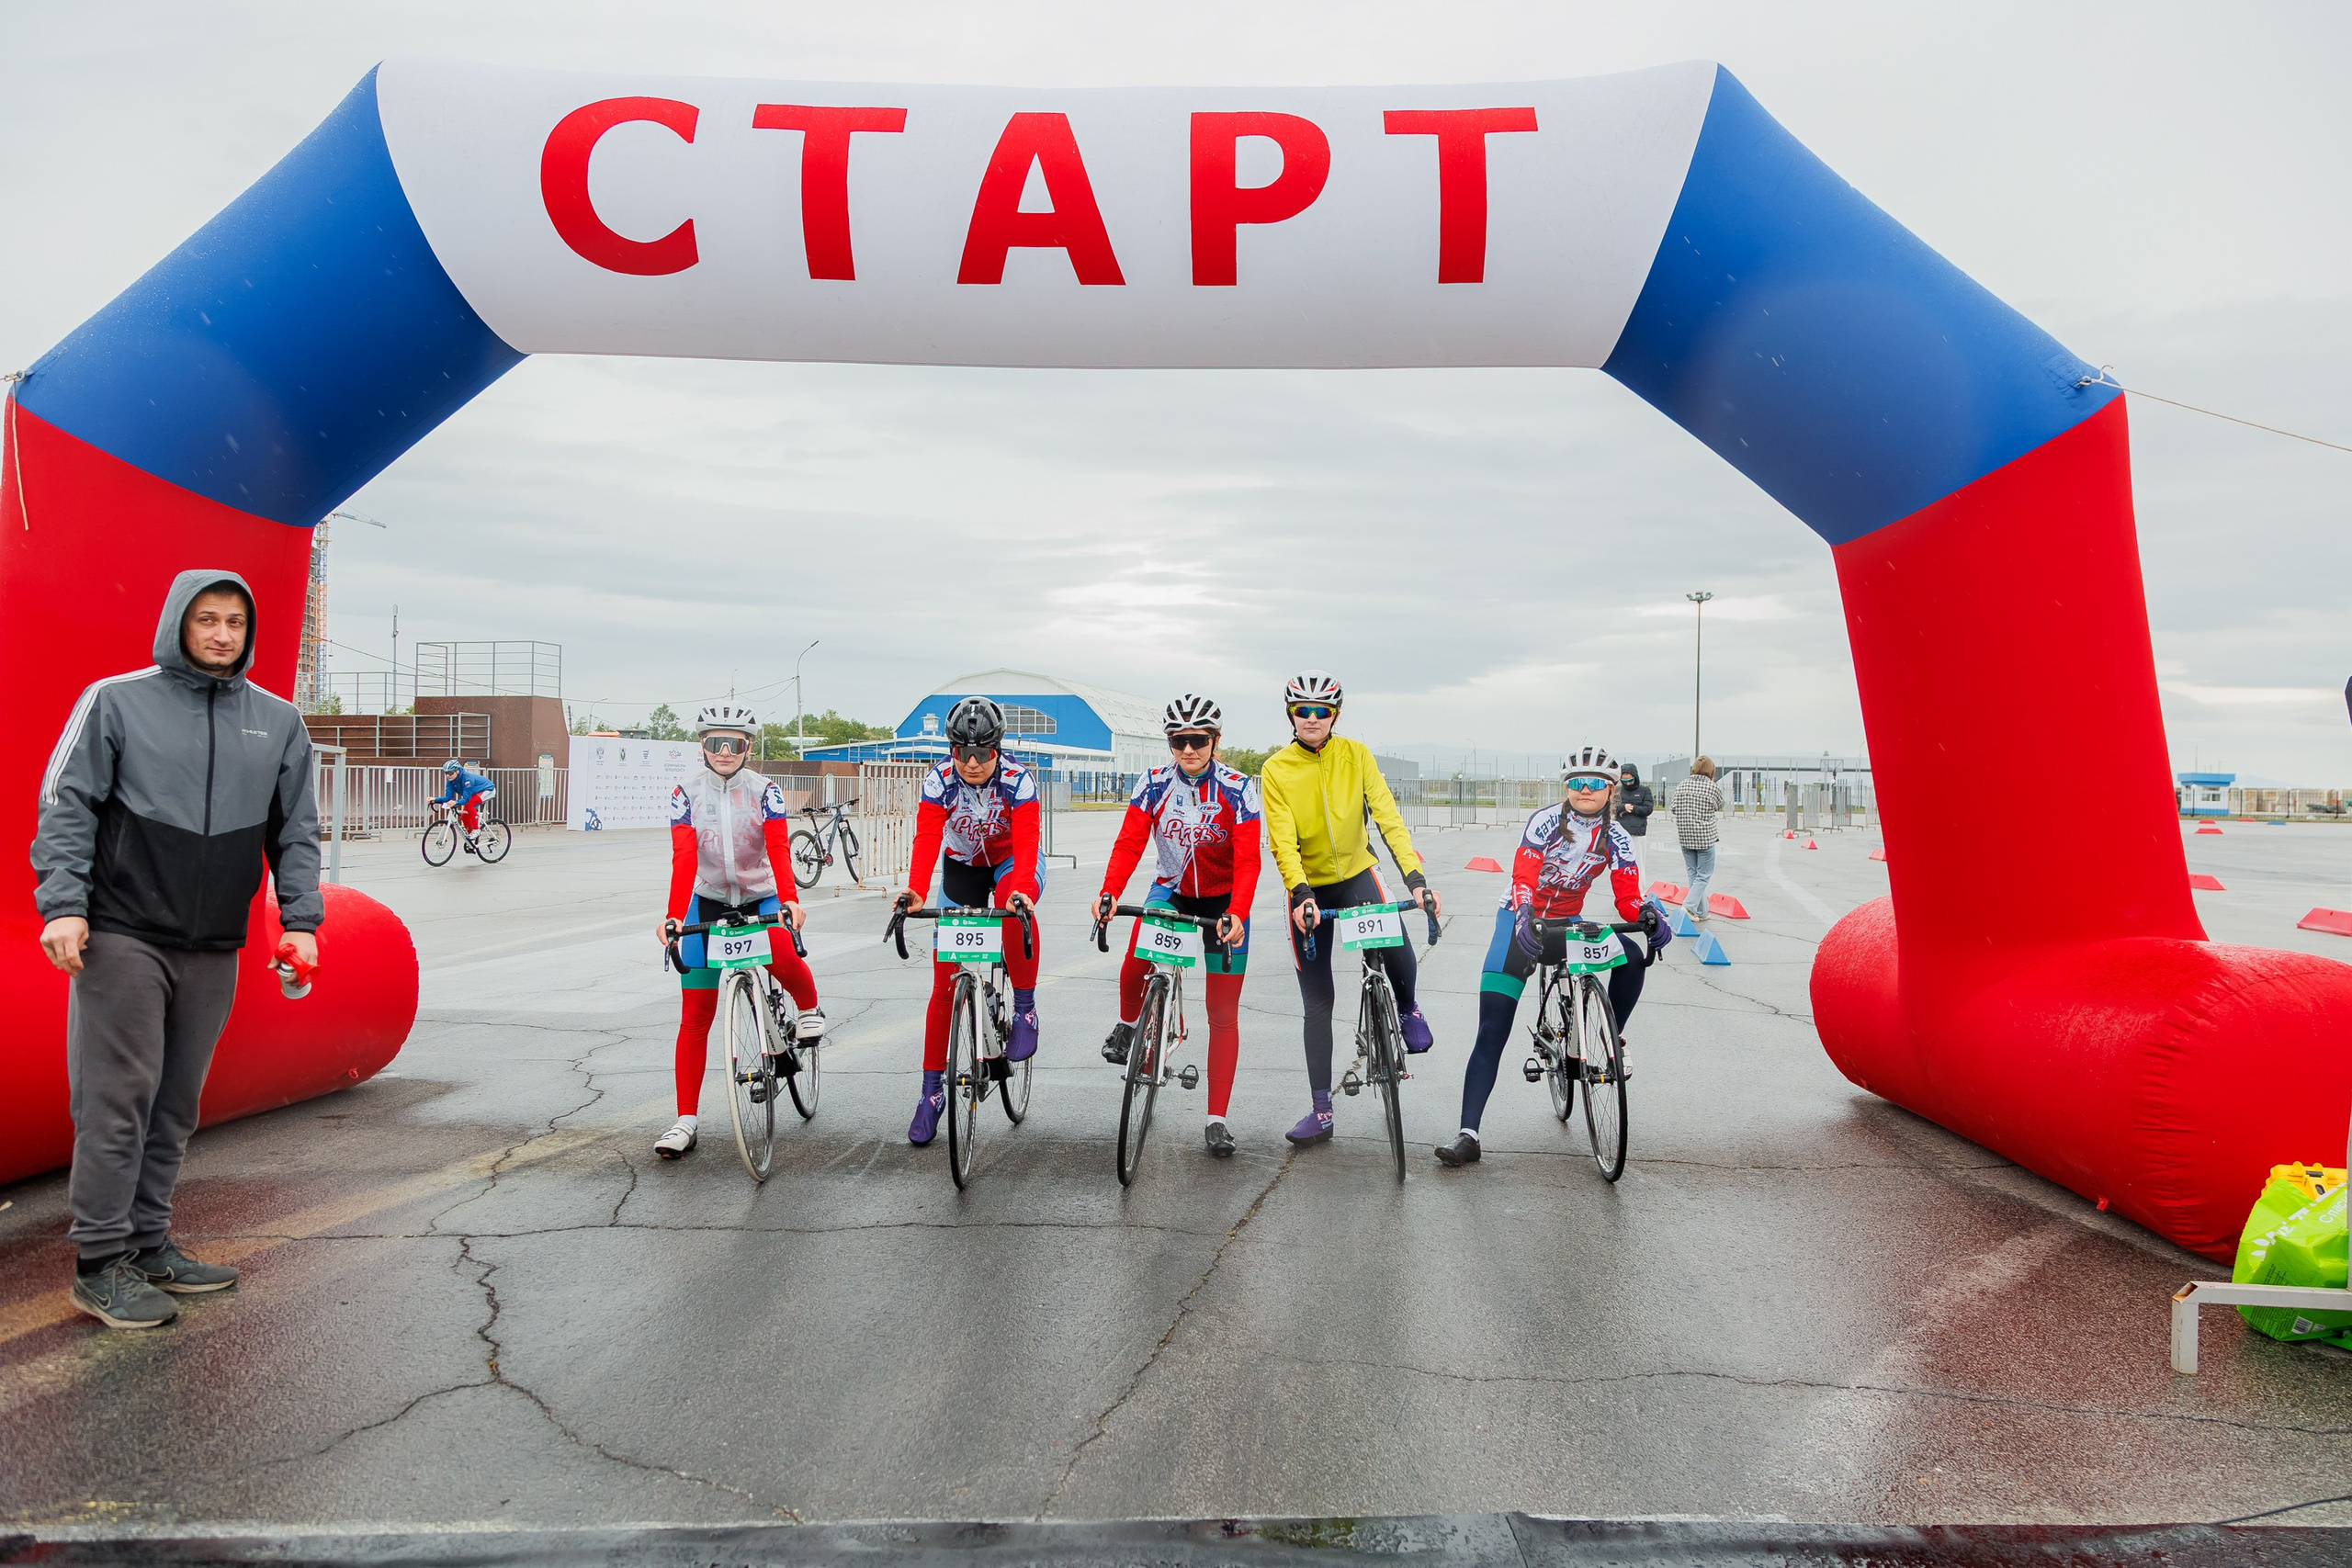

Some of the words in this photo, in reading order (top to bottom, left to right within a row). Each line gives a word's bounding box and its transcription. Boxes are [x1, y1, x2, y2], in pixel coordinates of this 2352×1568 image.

[540, 96, 1539, 287] СТАРТ
[1357, 919, 1384, 934] 891
[724, 939, 752, 955] 897
[956, 932, 984, 946] 895
[1154, 932, 1182, 950] 859
[1583, 944, 1609, 959] 857
[2318, 1197, 2347, 1224] Спас
